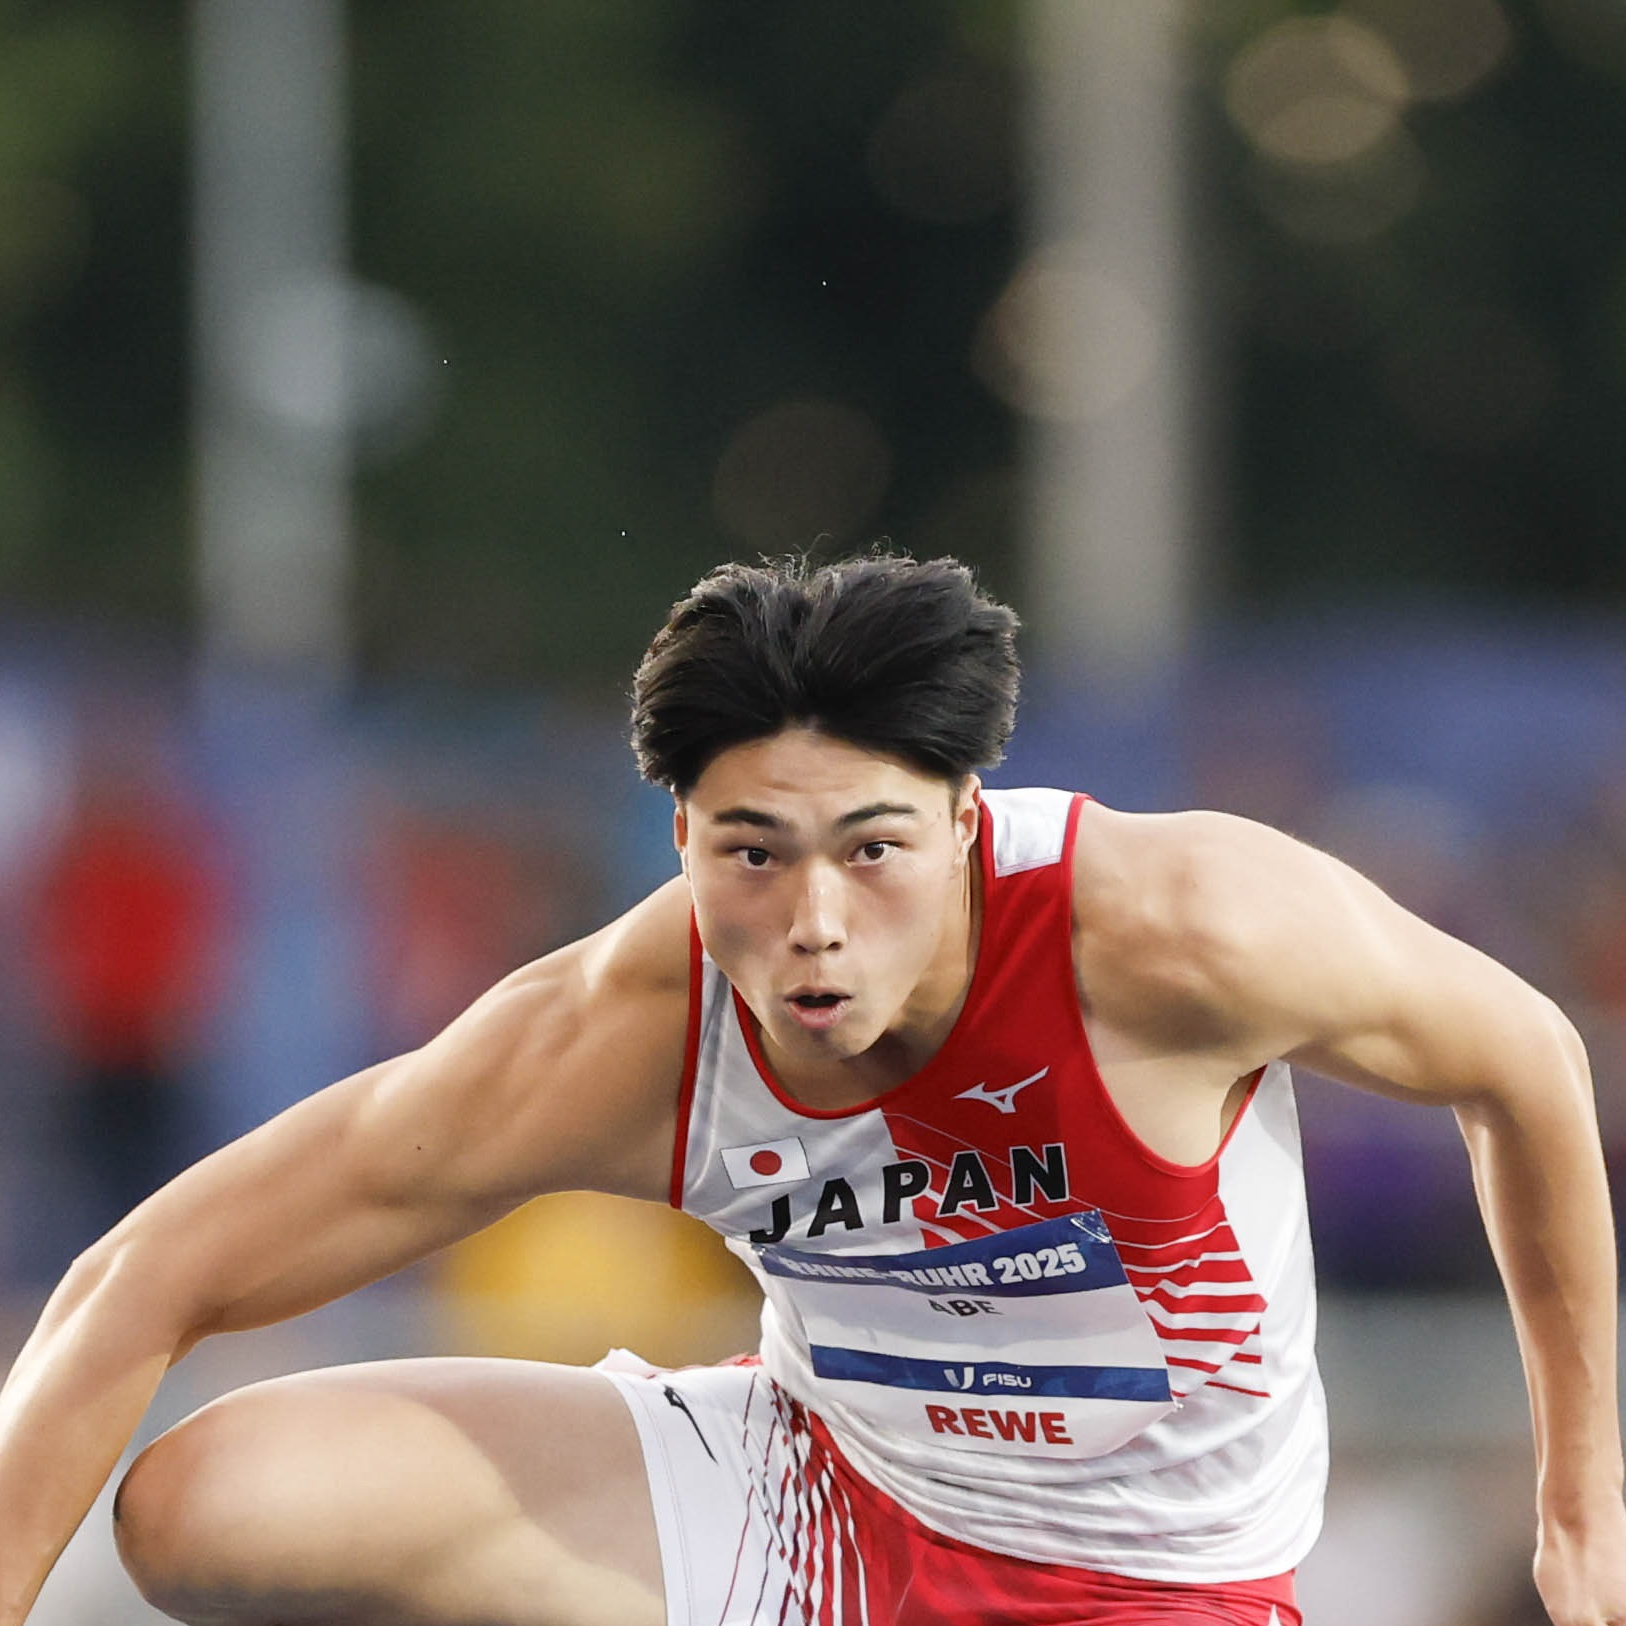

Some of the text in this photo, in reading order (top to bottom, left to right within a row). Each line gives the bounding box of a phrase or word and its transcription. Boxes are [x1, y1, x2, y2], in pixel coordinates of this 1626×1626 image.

[749, 1142, 1070, 1244] JAPAN
[993, 1243, 1087, 1284] 2025
[983, 1372, 1031, 1390] FISU
[926, 1404, 1073, 1445] REWE
